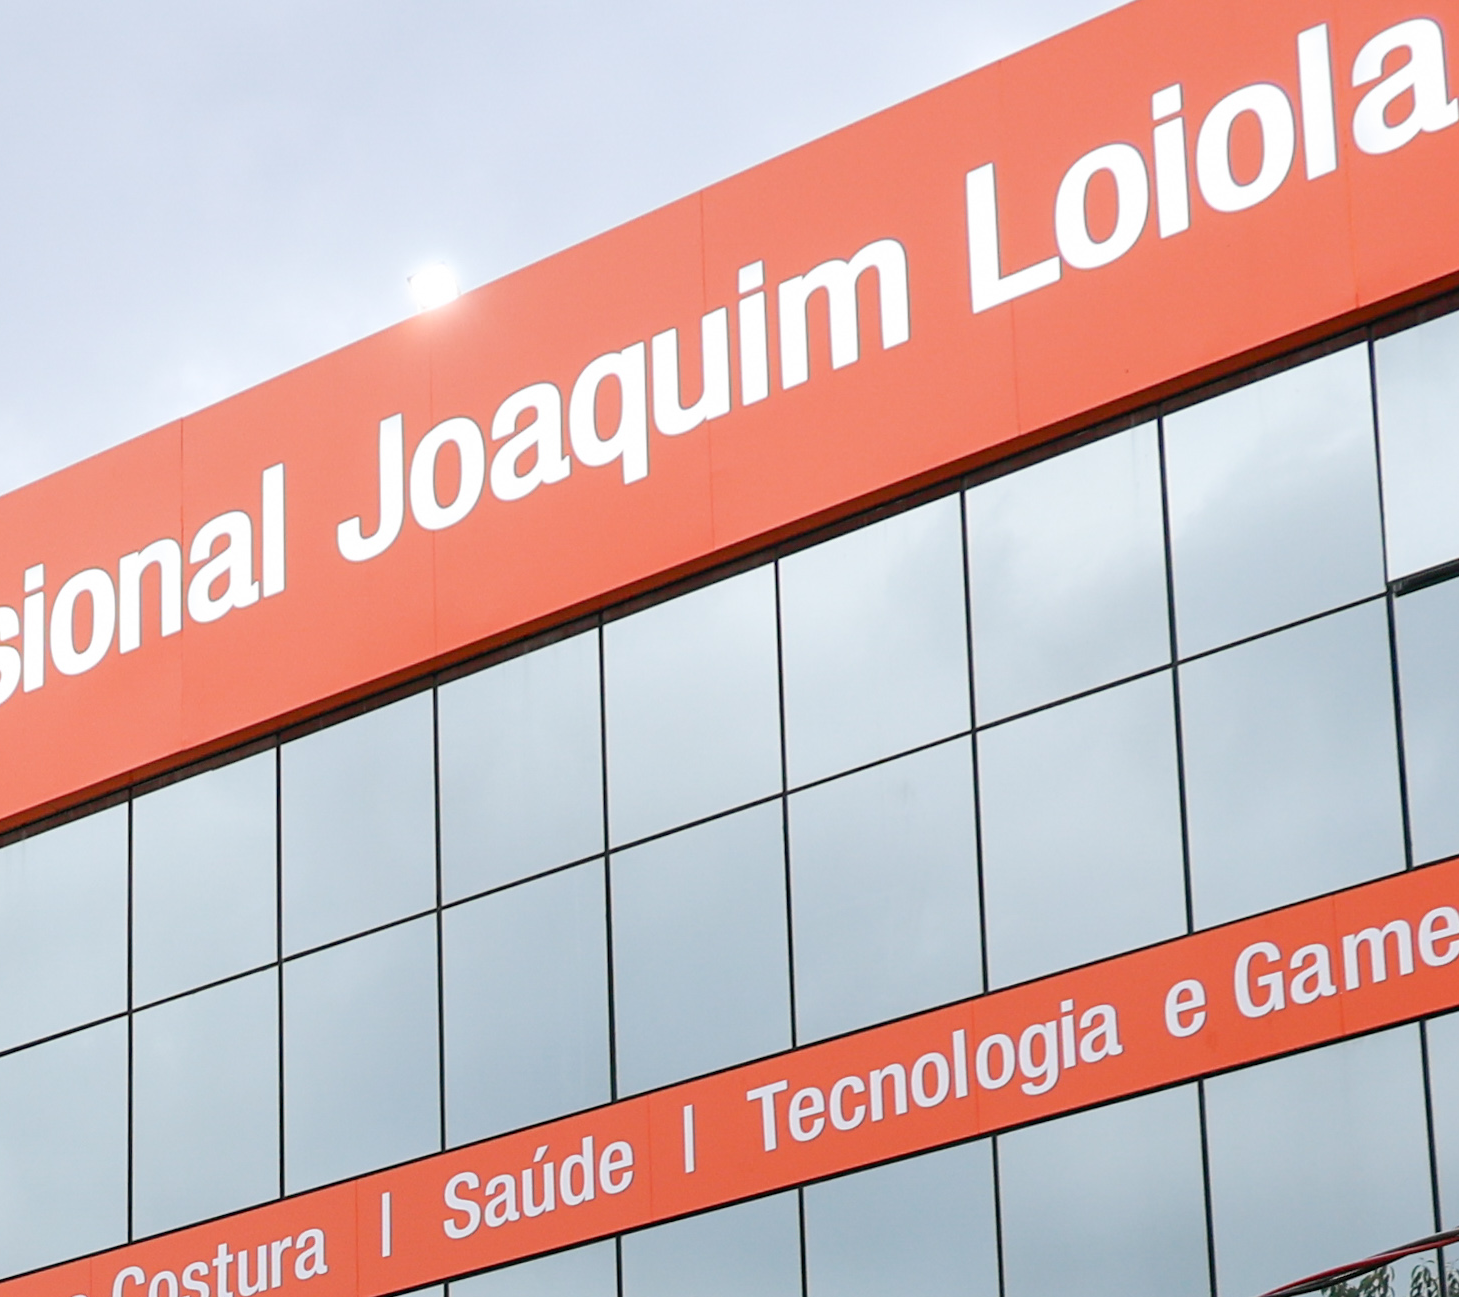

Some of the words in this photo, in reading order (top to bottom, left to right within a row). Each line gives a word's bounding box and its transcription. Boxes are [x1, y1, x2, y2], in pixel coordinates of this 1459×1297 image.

[334, 235, 912, 564] Joaquim
[442, 1134, 635, 1242] Saúde
[746, 999, 1123, 1153] Tecnologia
[1164, 976, 1208, 1039] e
